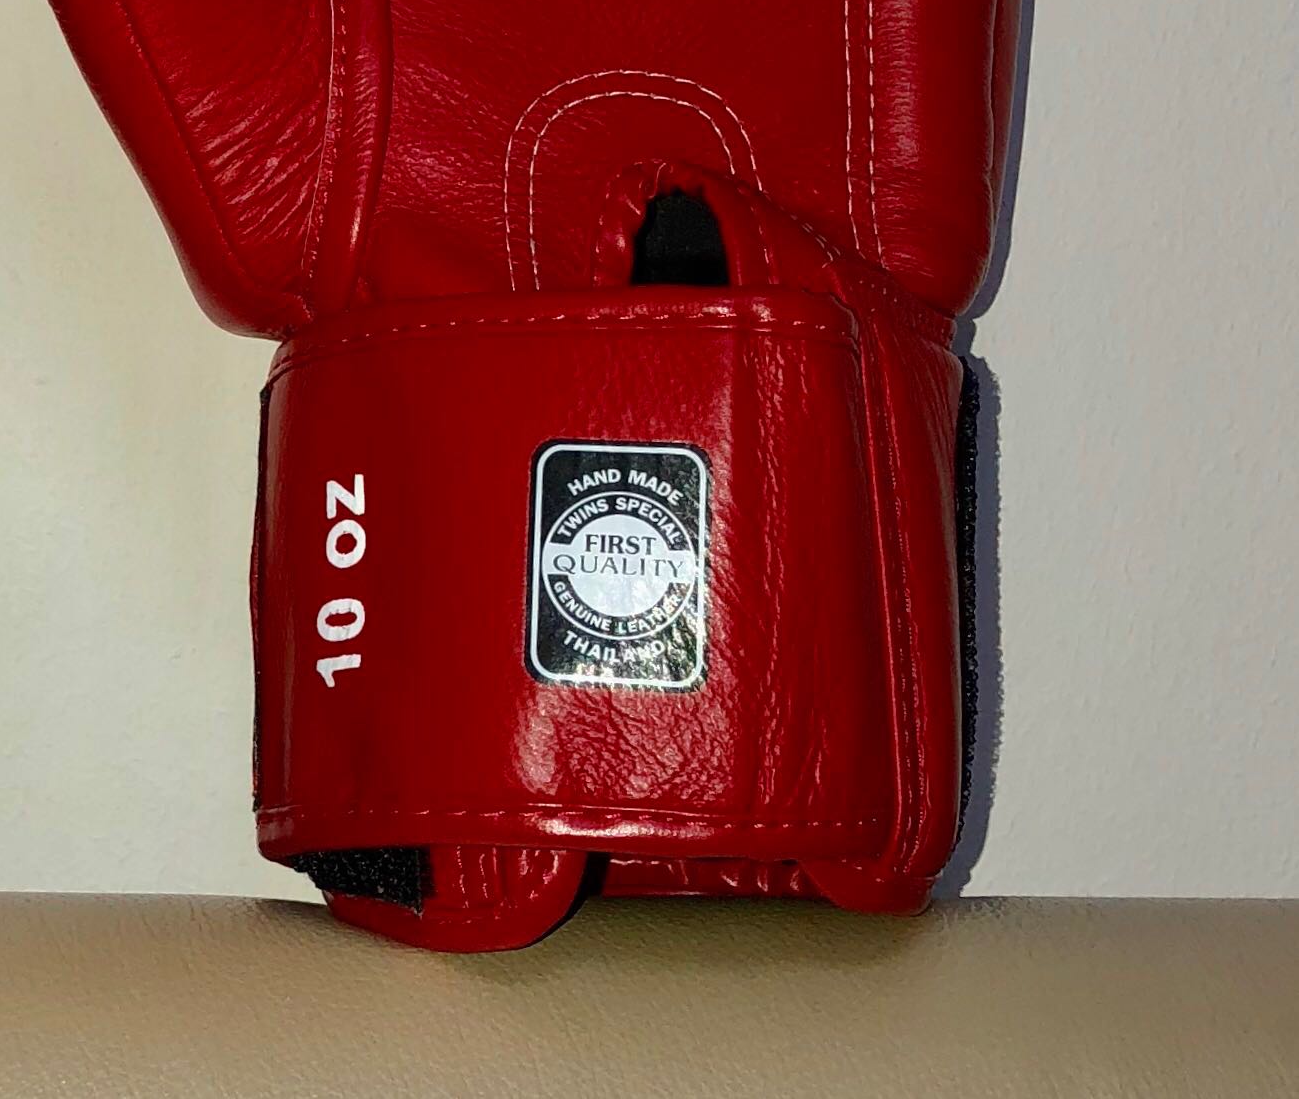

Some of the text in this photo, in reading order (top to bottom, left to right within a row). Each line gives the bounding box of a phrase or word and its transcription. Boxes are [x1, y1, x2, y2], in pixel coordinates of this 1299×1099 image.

[566, 467, 685, 506] HAND MADE
[557, 496, 684, 545] TWINS SPECIAL
[585, 533, 657, 555] FIRST
[553, 553, 685, 578] QUALITY
[553, 580, 684, 634] GENUINE LEATHER
[316, 598, 365, 688] 10
[563, 630, 666, 664] THAILAND
